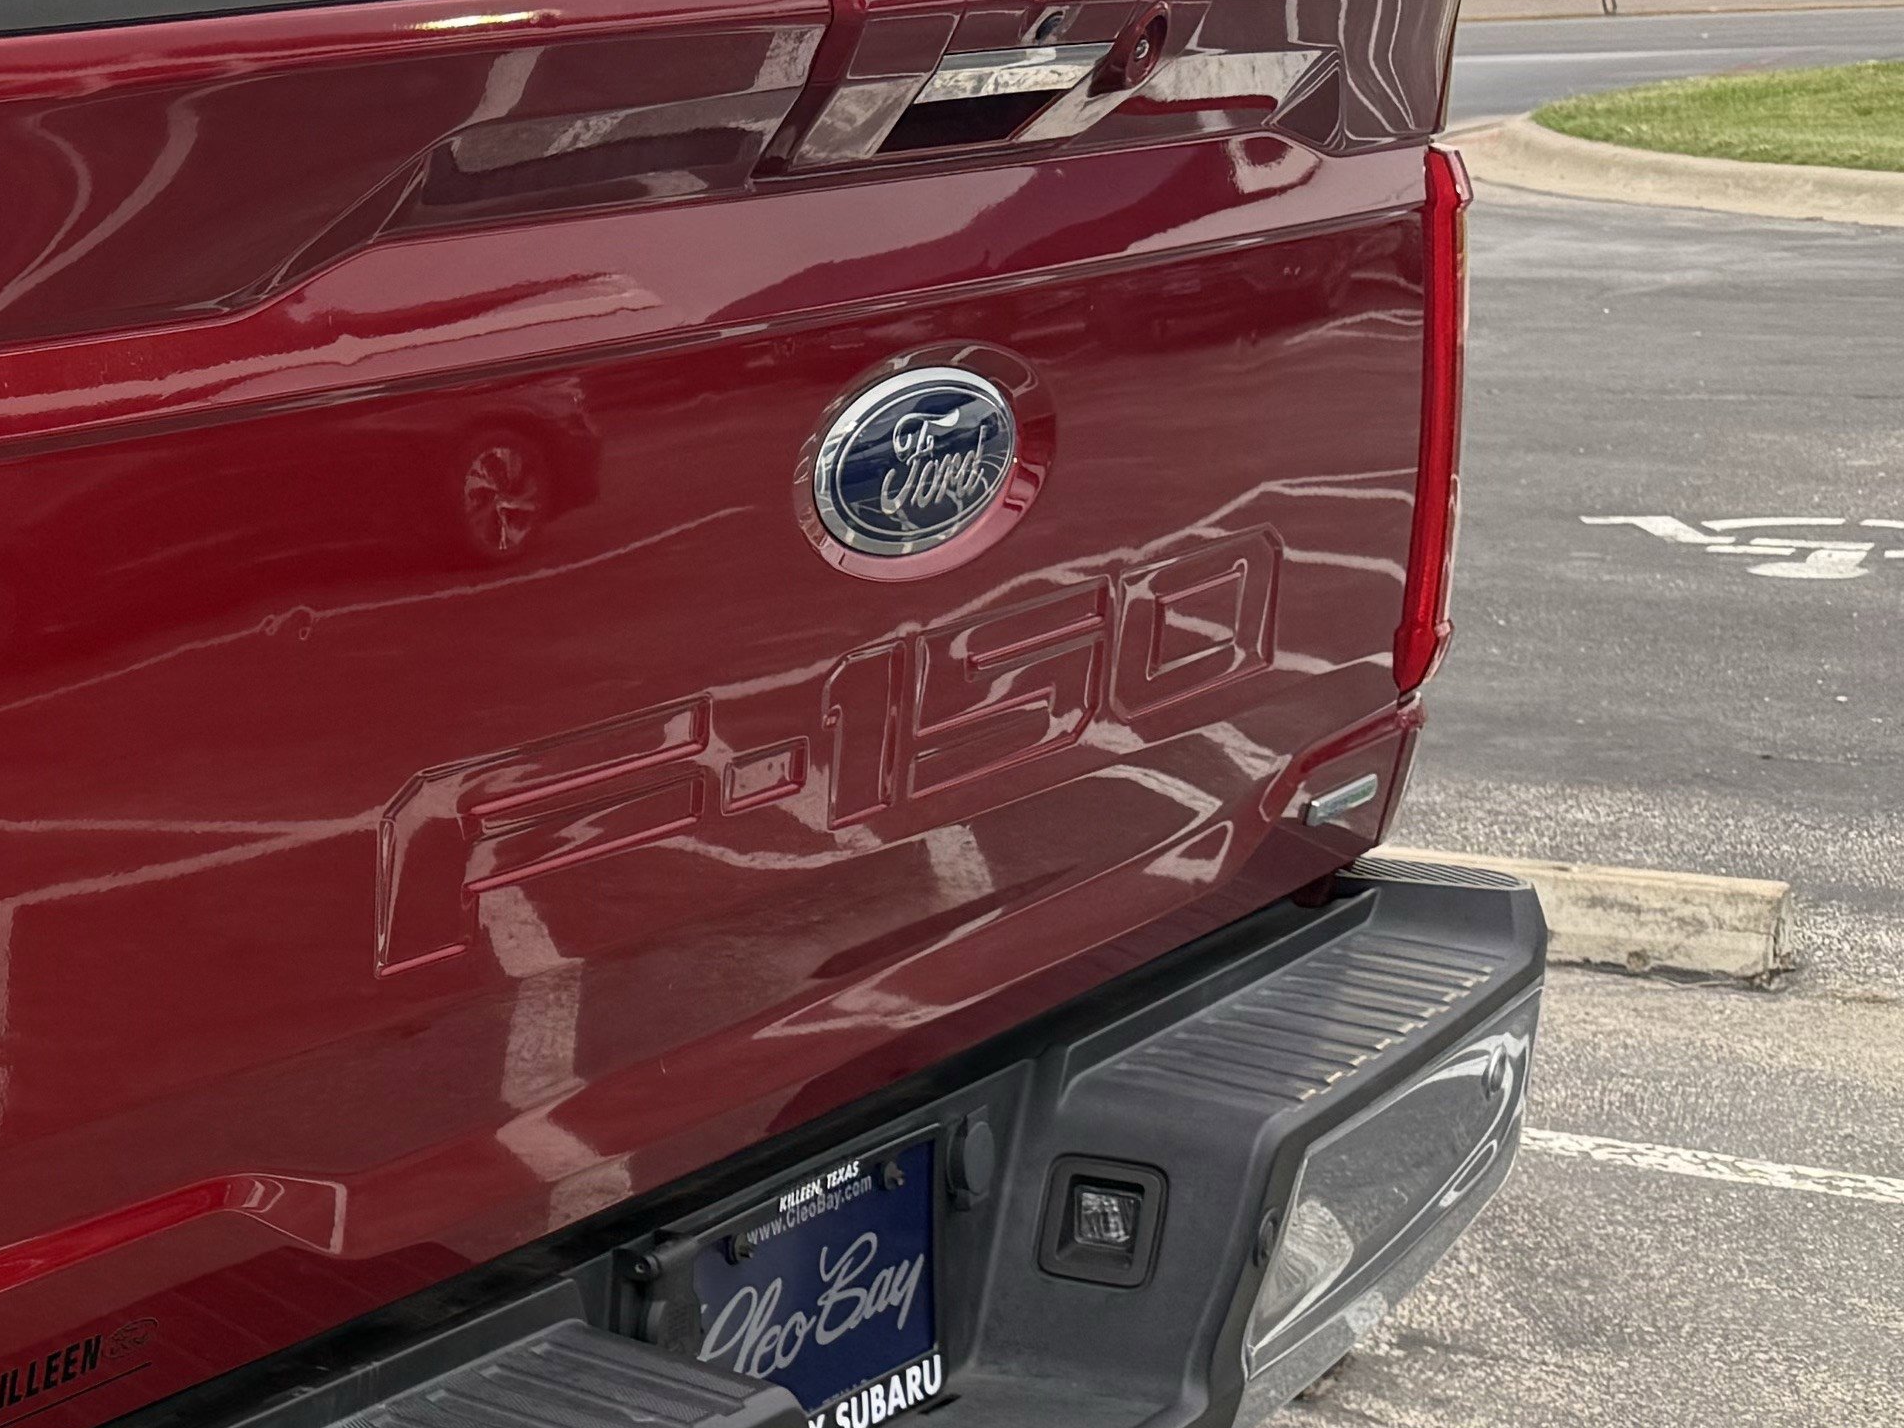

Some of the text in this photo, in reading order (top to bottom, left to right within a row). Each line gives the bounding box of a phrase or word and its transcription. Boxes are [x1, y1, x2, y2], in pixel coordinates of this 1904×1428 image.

[879, 408, 989, 515] Ford
[377, 523, 1284, 977] F-150
[746, 1175, 872, 1245] www.CleoBay.com
[779, 1160, 859, 1212] KILLEEN, TEXAS
[814, 1231, 925, 1346] Bay
